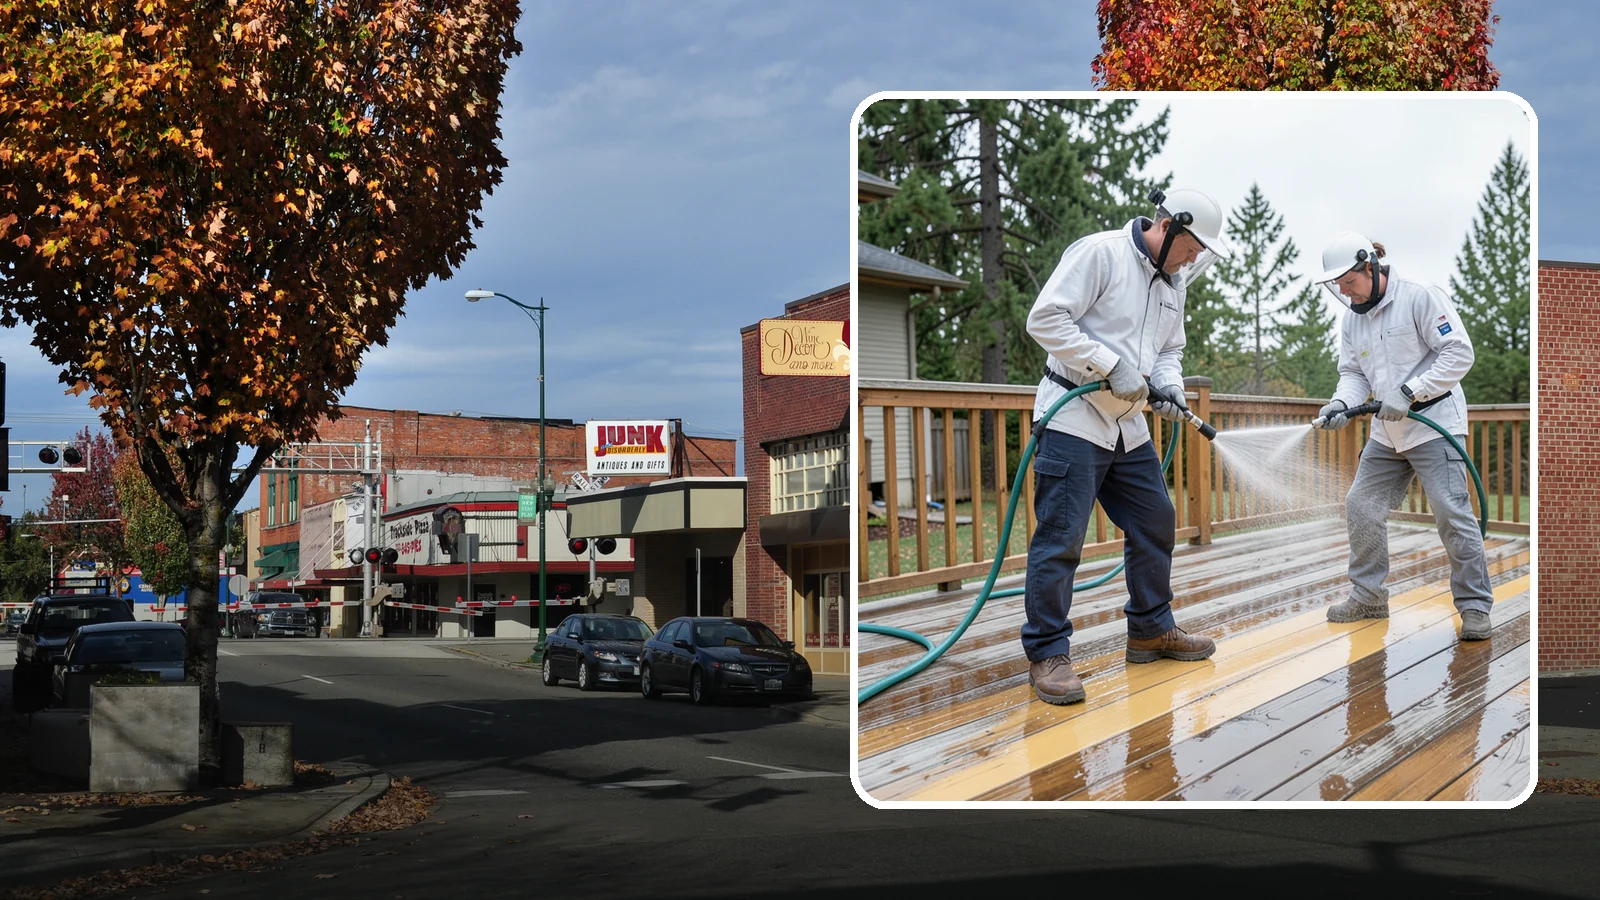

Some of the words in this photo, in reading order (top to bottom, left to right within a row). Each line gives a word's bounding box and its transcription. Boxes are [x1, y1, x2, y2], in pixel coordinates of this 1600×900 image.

[595, 425, 664, 457] JUNK
[607, 446, 646, 455] DISORDERLY
[596, 461, 628, 470] ANTIQUES
[630, 461, 644, 470] AND
[646, 460, 665, 469] GIFTS
[589, 476, 607, 492] SING
[414, 519, 429, 535] Pizza
